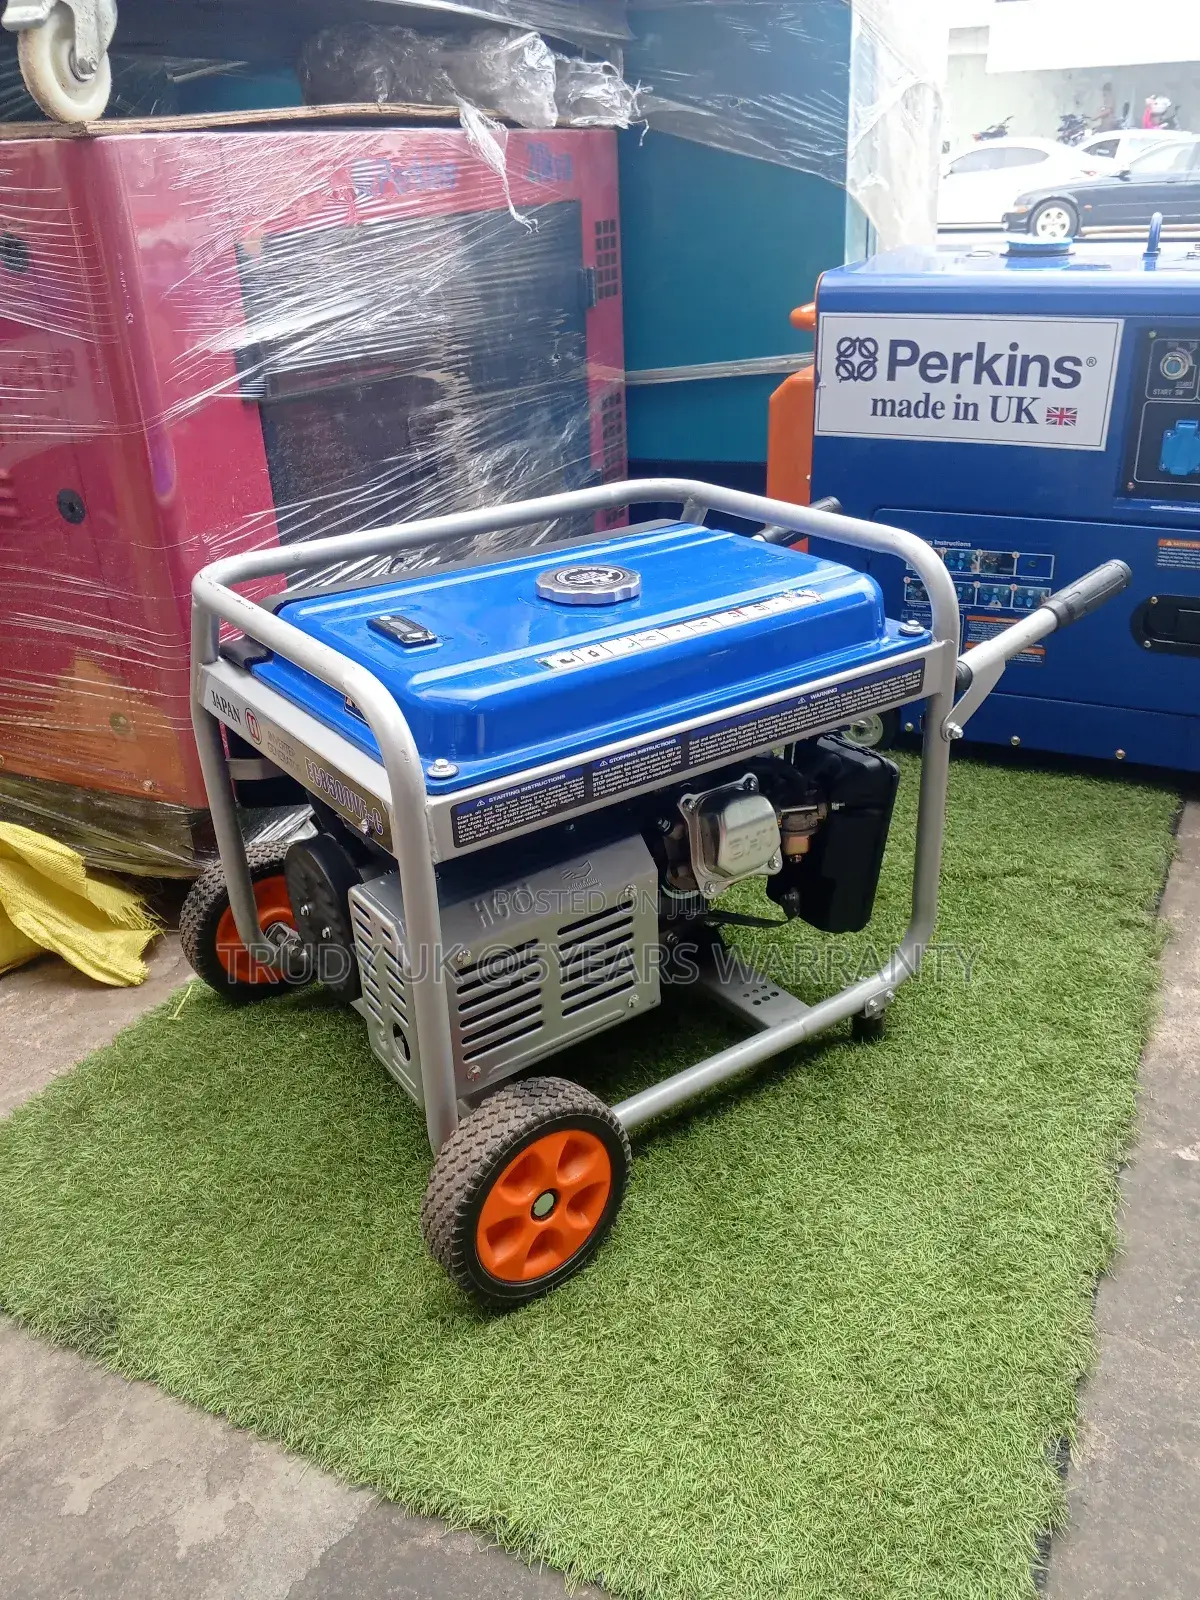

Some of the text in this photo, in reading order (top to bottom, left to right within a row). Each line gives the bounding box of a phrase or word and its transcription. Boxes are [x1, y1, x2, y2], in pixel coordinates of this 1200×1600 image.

[887, 340, 1082, 389] Perkins
[870, 392, 1041, 424] made in UK
[934, 539, 971, 547] Instructions
[211, 690, 241, 725] JAPAN
[810, 687, 838, 700] WARNING
[609, 752, 636, 764] STOPPING
[638, 738, 676, 755] INSTRUCTIONS
[488, 775, 565, 803] STARTING INSTRUCTIONS
